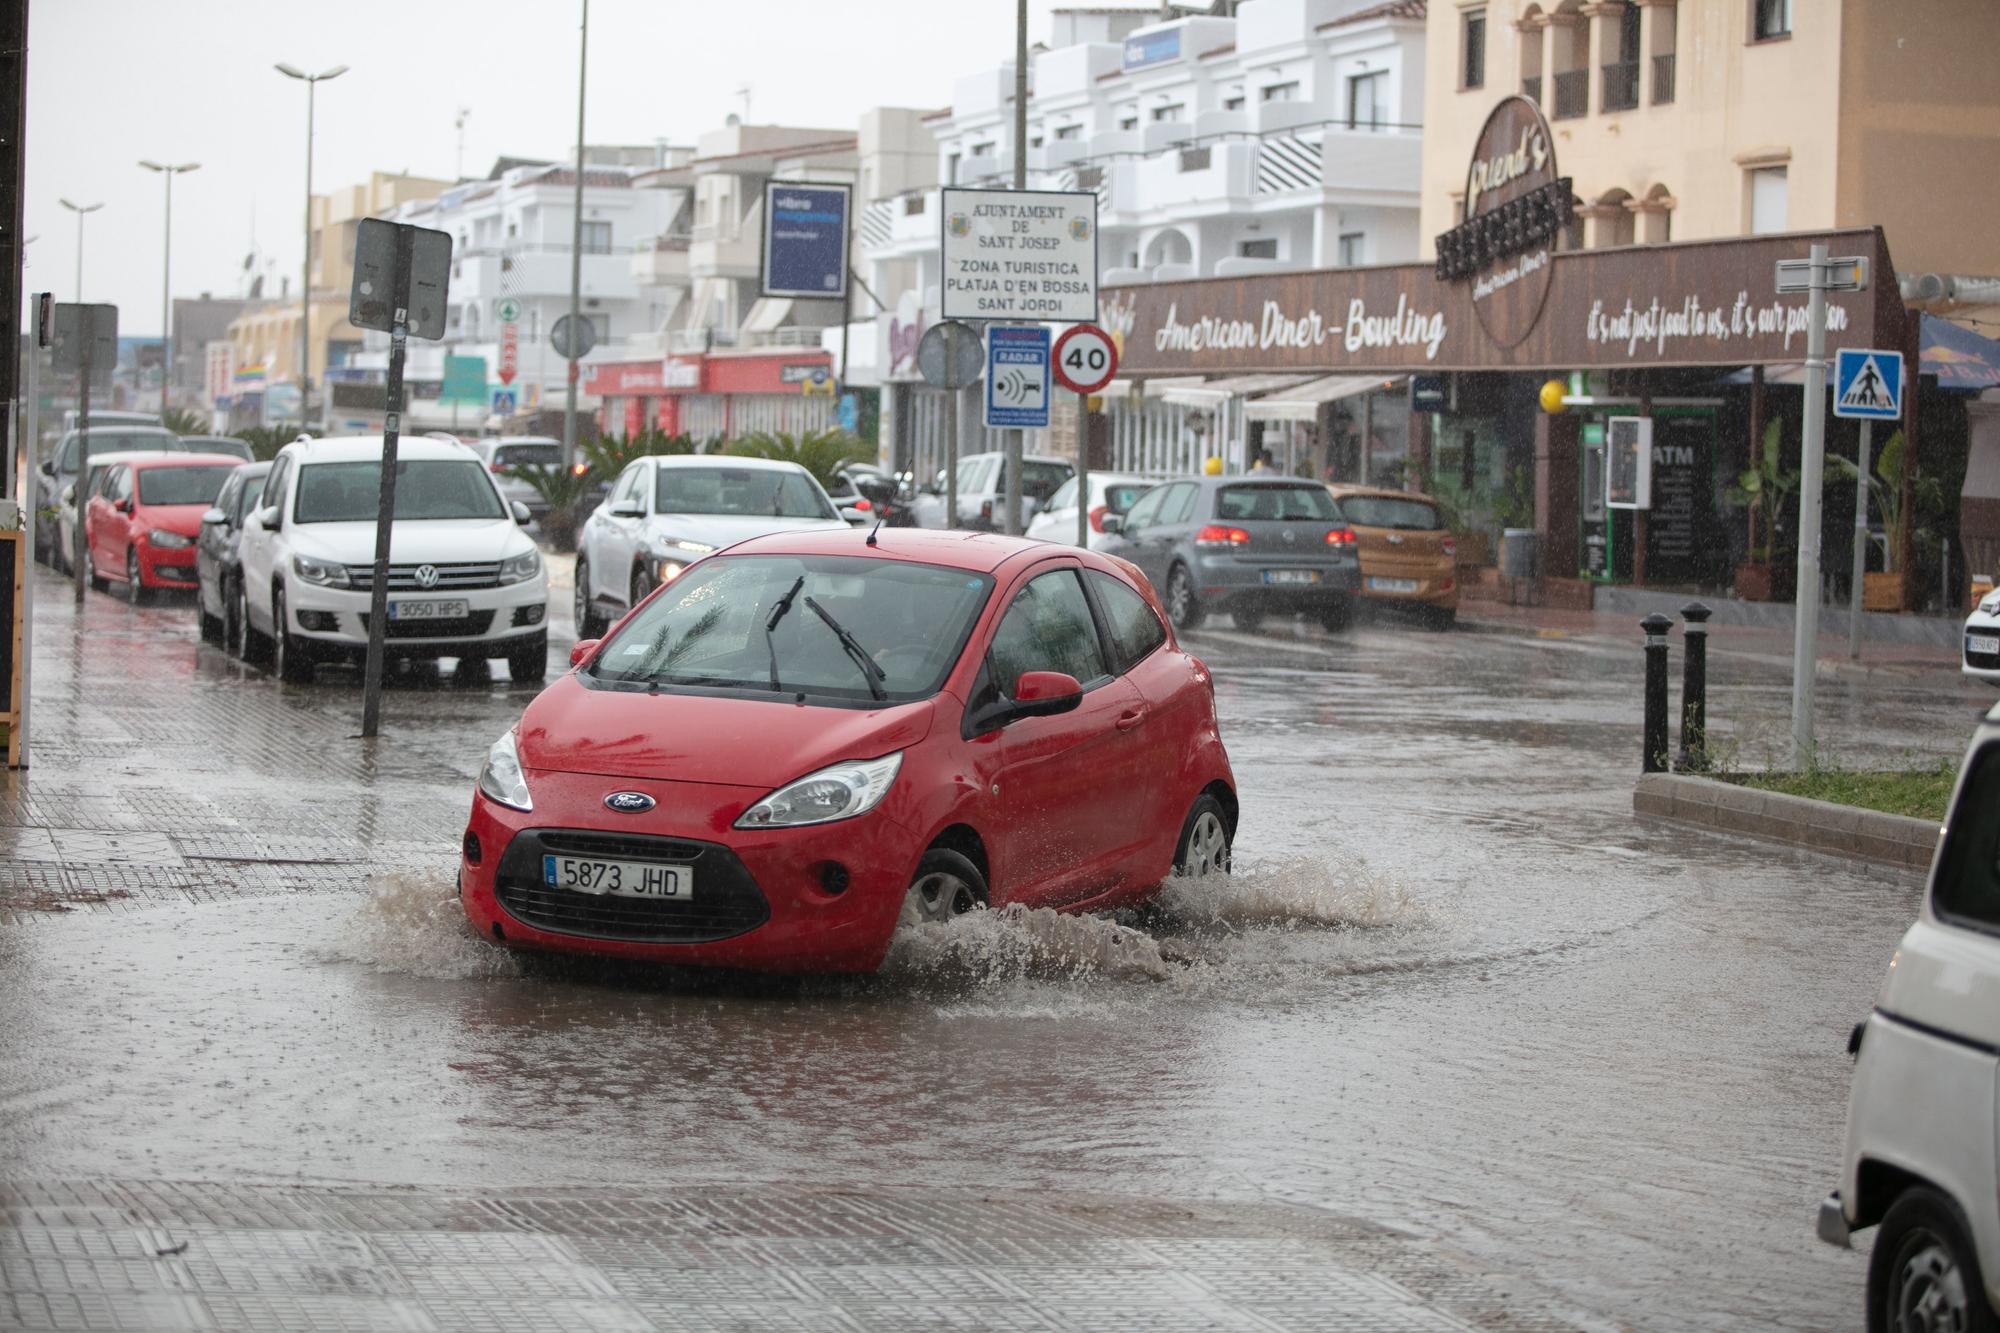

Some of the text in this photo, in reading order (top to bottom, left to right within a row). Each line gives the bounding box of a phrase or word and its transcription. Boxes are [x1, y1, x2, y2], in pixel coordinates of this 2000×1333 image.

[972, 204, 1065, 219] AJUNTAMENT
[1012, 220, 1030, 234] DE
[979, 237, 1061, 250] SANT JOSEP
[960, 260, 1079, 275] ZONA TURISTICA
[947, 278, 1090, 294] PLATJA D'EN BOSSA
[978, 298, 1062, 312] SANT JORDI
[1610, 298, 1632, 340] not
[1690, 294, 1706, 336] to
[1758, 301, 1785, 333] our
[1156, 303, 1257, 351] American
[1260, 300, 1325, 350] Diner
[1345, 293, 1447, 360] Bowling
[999, 352, 1039, 363] RADAR
[1065, 348, 1105, 370] 40
[1651, 446, 1693, 465] ATM
[401, 601, 463, 616] 3050 HPS
[613, 793, 644, 808] Ford
[564, 859, 622, 891] 5873
[633, 867, 678, 896] JHD
